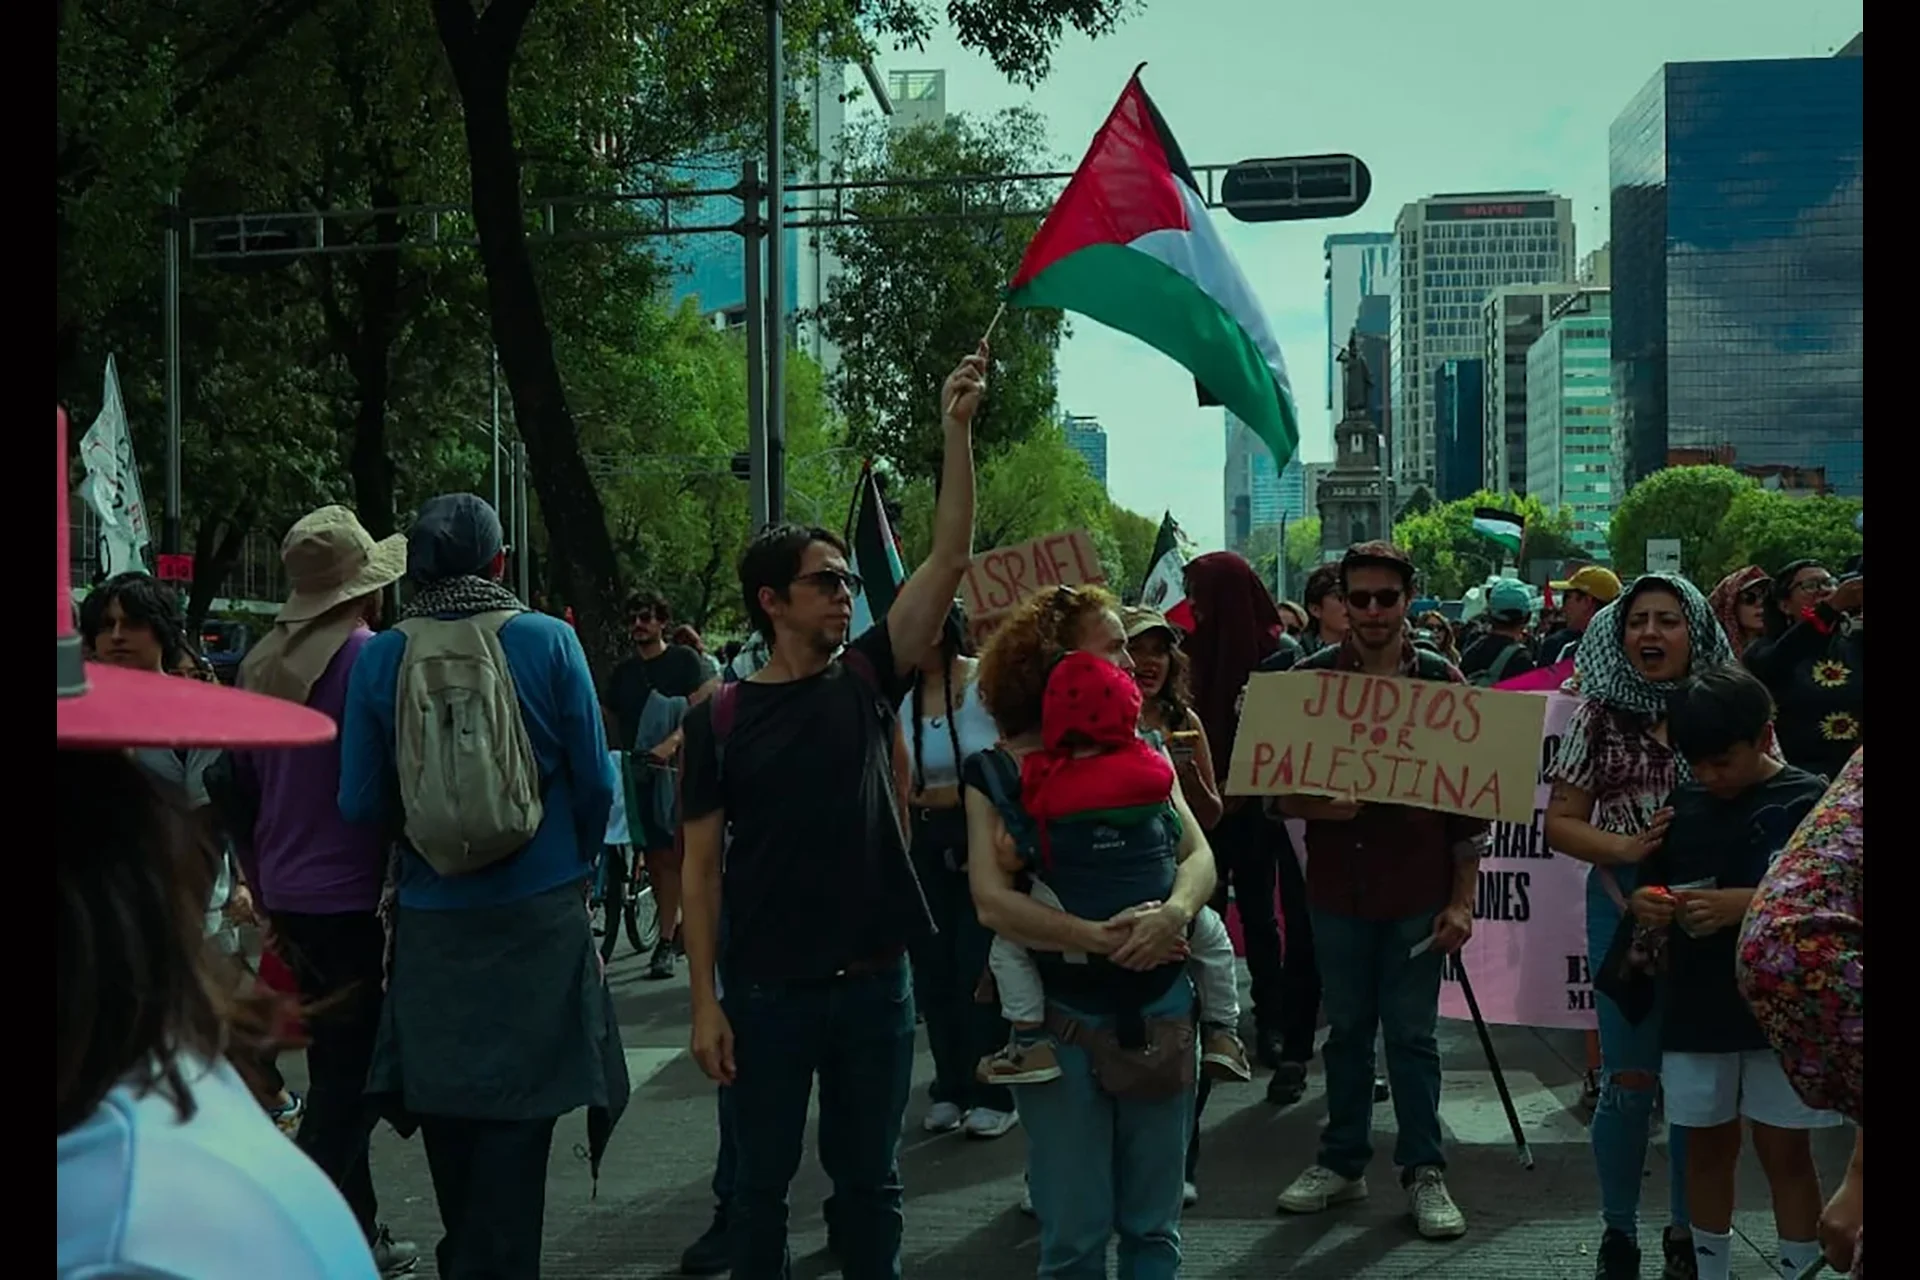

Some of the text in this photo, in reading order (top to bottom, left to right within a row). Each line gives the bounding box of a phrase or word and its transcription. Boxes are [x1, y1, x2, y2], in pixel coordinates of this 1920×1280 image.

[968, 534, 1105, 614] ISRAEL
[1303, 672, 1481, 742] JUDIOS
[1351, 722, 1414, 750] POR
[1251, 742, 1501, 814] PALESTINA
